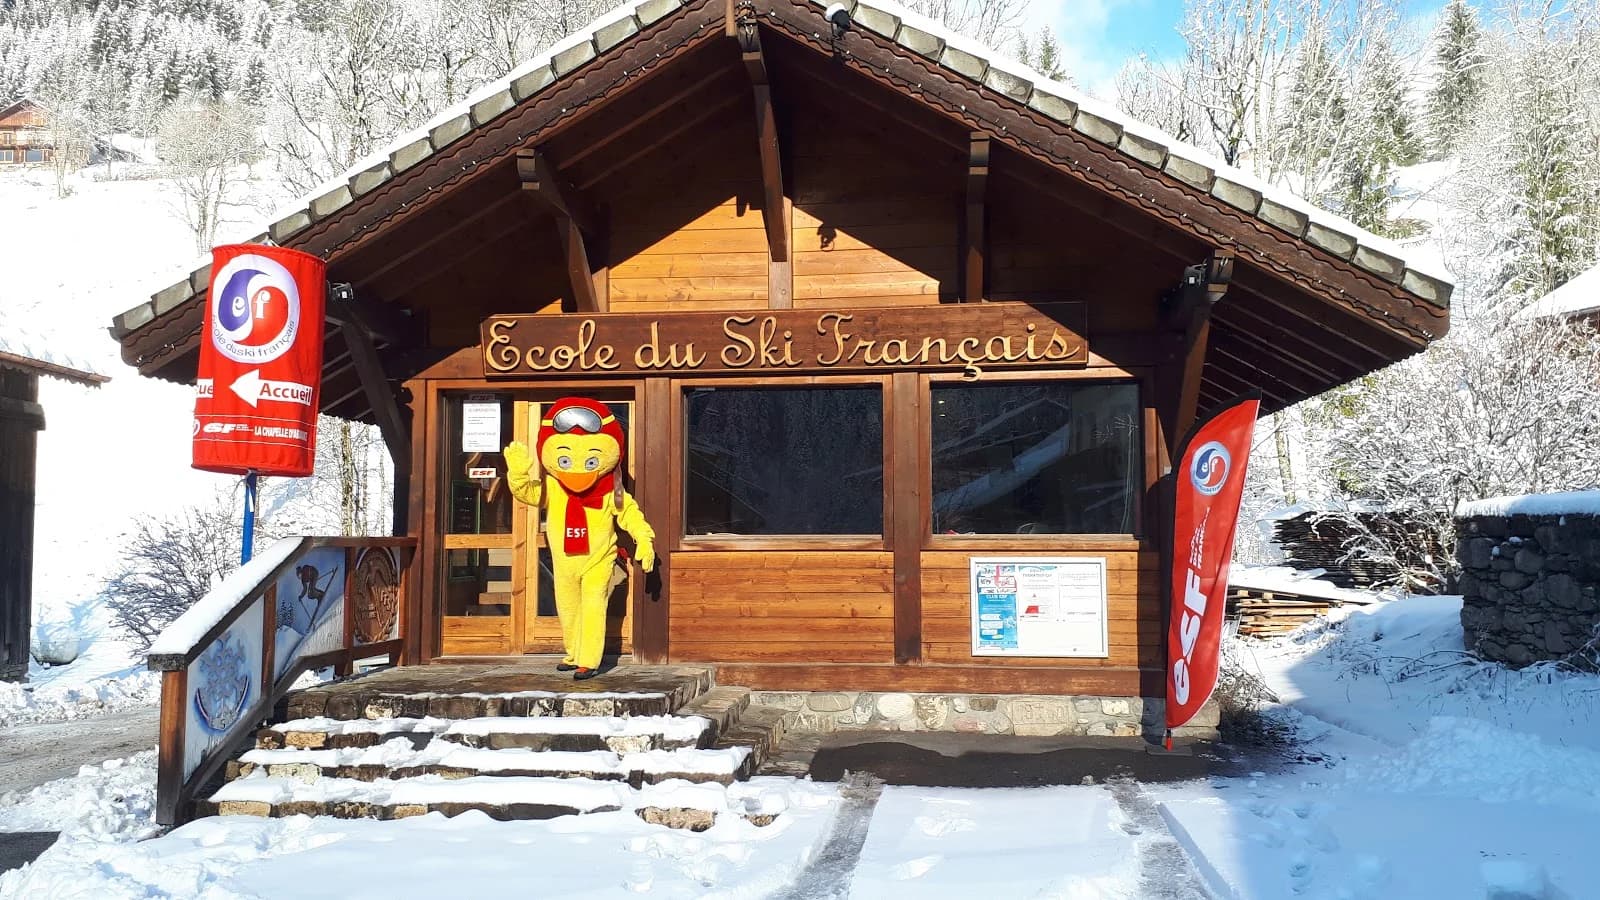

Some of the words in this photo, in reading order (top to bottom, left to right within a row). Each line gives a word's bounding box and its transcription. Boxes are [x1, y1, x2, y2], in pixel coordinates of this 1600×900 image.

[486, 319, 620, 371] Ecole
[634, 321, 706, 368] du
[720, 315, 803, 367] Ski
[816, 312, 1080, 382] Français
[259, 382, 313, 403] Accueil
[566, 527, 587, 538] ESF
